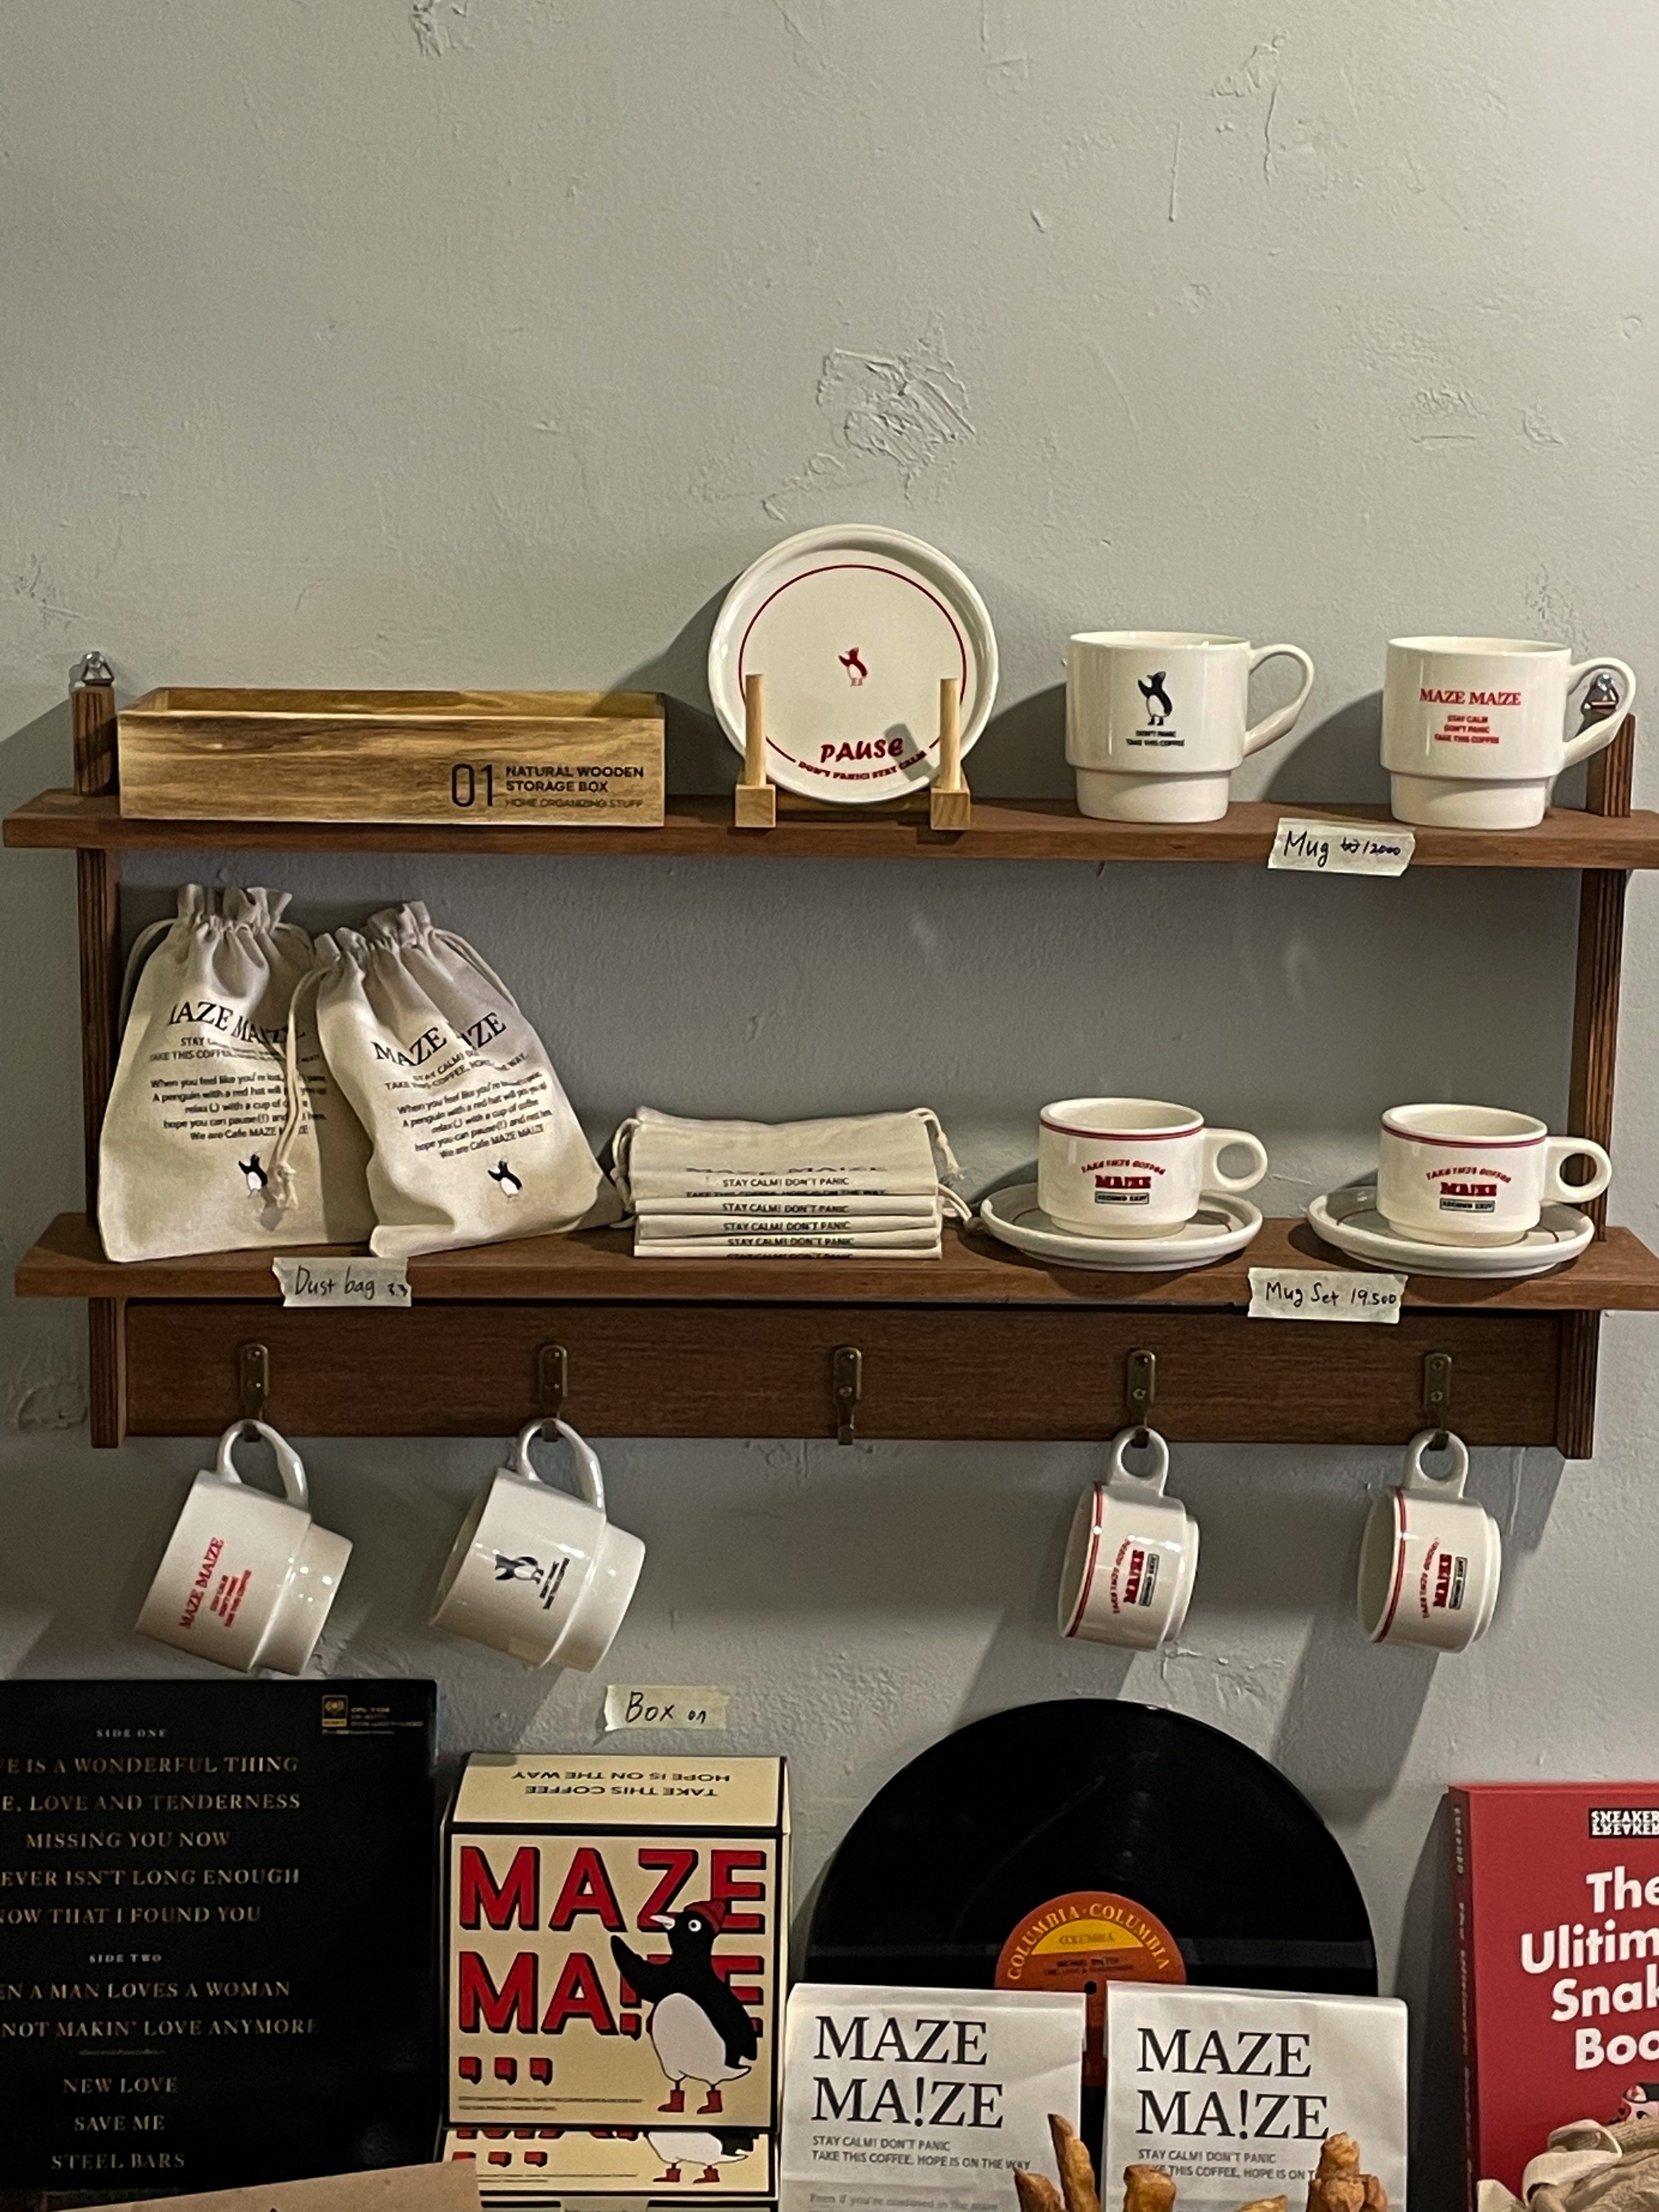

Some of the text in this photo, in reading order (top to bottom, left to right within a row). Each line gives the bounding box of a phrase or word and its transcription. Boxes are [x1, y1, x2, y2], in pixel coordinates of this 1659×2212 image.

[1420, 688, 1465, 704] MAZE
[820, 738, 904, 763] PAUSE
[506, 766, 644, 778] NATURAL WOODEN
[452, 763, 493, 807] 01
[506, 780, 608, 792] STORAGE BOX
[506, 798, 538, 807] HOME
[609, 799, 643, 808] STUFF
[1284, 831, 1329, 867] Mug
[180, 1037, 205, 1046] STAY
[371, 1027, 447, 1066] MAZE
[172, 1051, 194, 1060] THIS
[723, 1179, 747, 1187] STAY
[723, 1203, 747, 1211] STAY
[724, 1223, 748, 1231] STAY
[821, 1221, 850, 1229] PANIC
[295, 1265, 336, 1296] Dust
[345, 1265, 375, 1300] bag
[1266, 1282, 1302, 1307] Mug
[1311, 1282, 1339, 1306] Set
[625, 1691, 675, 1723] Box
[96, 1729, 167, 1738] SIDE ONE
[0, 1757, 299, 1774] E IS A WONDERFUL THING
[672, 1773, 731, 1782] HOPE
[526, 1786, 718, 1797] TAKE THIS COFFEE
[30, 1795, 88, 1811] LOVE
[95, 1795, 143, 1810] AND
[150, 1793, 300, 1811] TENDERNESS
[26, 1831, 231, 1849] MISSING YOU NOW
[66, 1870, 126, 1886] ISN'T
[133, 1869, 196, 1886] LONG
[203, 1869, 300, 1885] ENOUGH
[460, 1846, 766, 1935] MAZE
[48, 1908, 110, 1924] THAT
[117, 1908, 122, 1923] I
[131, 1906, 210, 1924] FOUND
[217, 1906, 261, 1922] YOU
[1007, 1903, 1170, 1980] COLUMBIA COLUMBIA
[89, 1954, 162, 1963] SIDE TWO
[29, 1984, 43, 1999] A
[49, 1983, 100, 1999] MAN
[108, 1982, 178, 1999] LOVES
[185, 1983, 198, 1997] A
[206, 1980, 290, 1997] WOMAN
[2, 2021, 50, 2038] NOT
[144, 2019, 202, 2036] LOVE
[814, 2015, 987, 2065] MAZE
[1136, 2028, 1311, 2078] MAZE
[63, 2076, 178, 2094] NEW LOVE
[811, 2076, 1003, 2129] MA!ZE
[74, 2114, 165, 2132] SAVE ME
[1136, 2089, 1329, 2140] MA!ZE
[812, 2135, 840, 2147] STAY
[881, 2138, 915, 2150] DON'T
[918, 2140, 951, 2152] PANIC
[51, 2153, 185, 2170] STEEL BARS
[812, 2150, 839, 2162] TAKE
[843, 2151, 867, 2163] THIS
[917, 2155, 947, 2166] HOPE
[950, 2156, 960, 2166] IS
[962, 2157, 978, 2168] ON
[981, 2158, 1003, 2169] THE
[1138, 2149, 1166, 2160] STAY
[1206, 2151, 1242, 2162] DON'T
[1244, 2153, 1276, 2164] PANIC
[1169, 2165, 1193, 2176] THIS
[1244, 2168, 1274, 2180] HOPE
[1276, 2169, 1286, 2179] IS
[1289, 2170, 1305, 2180] ON
